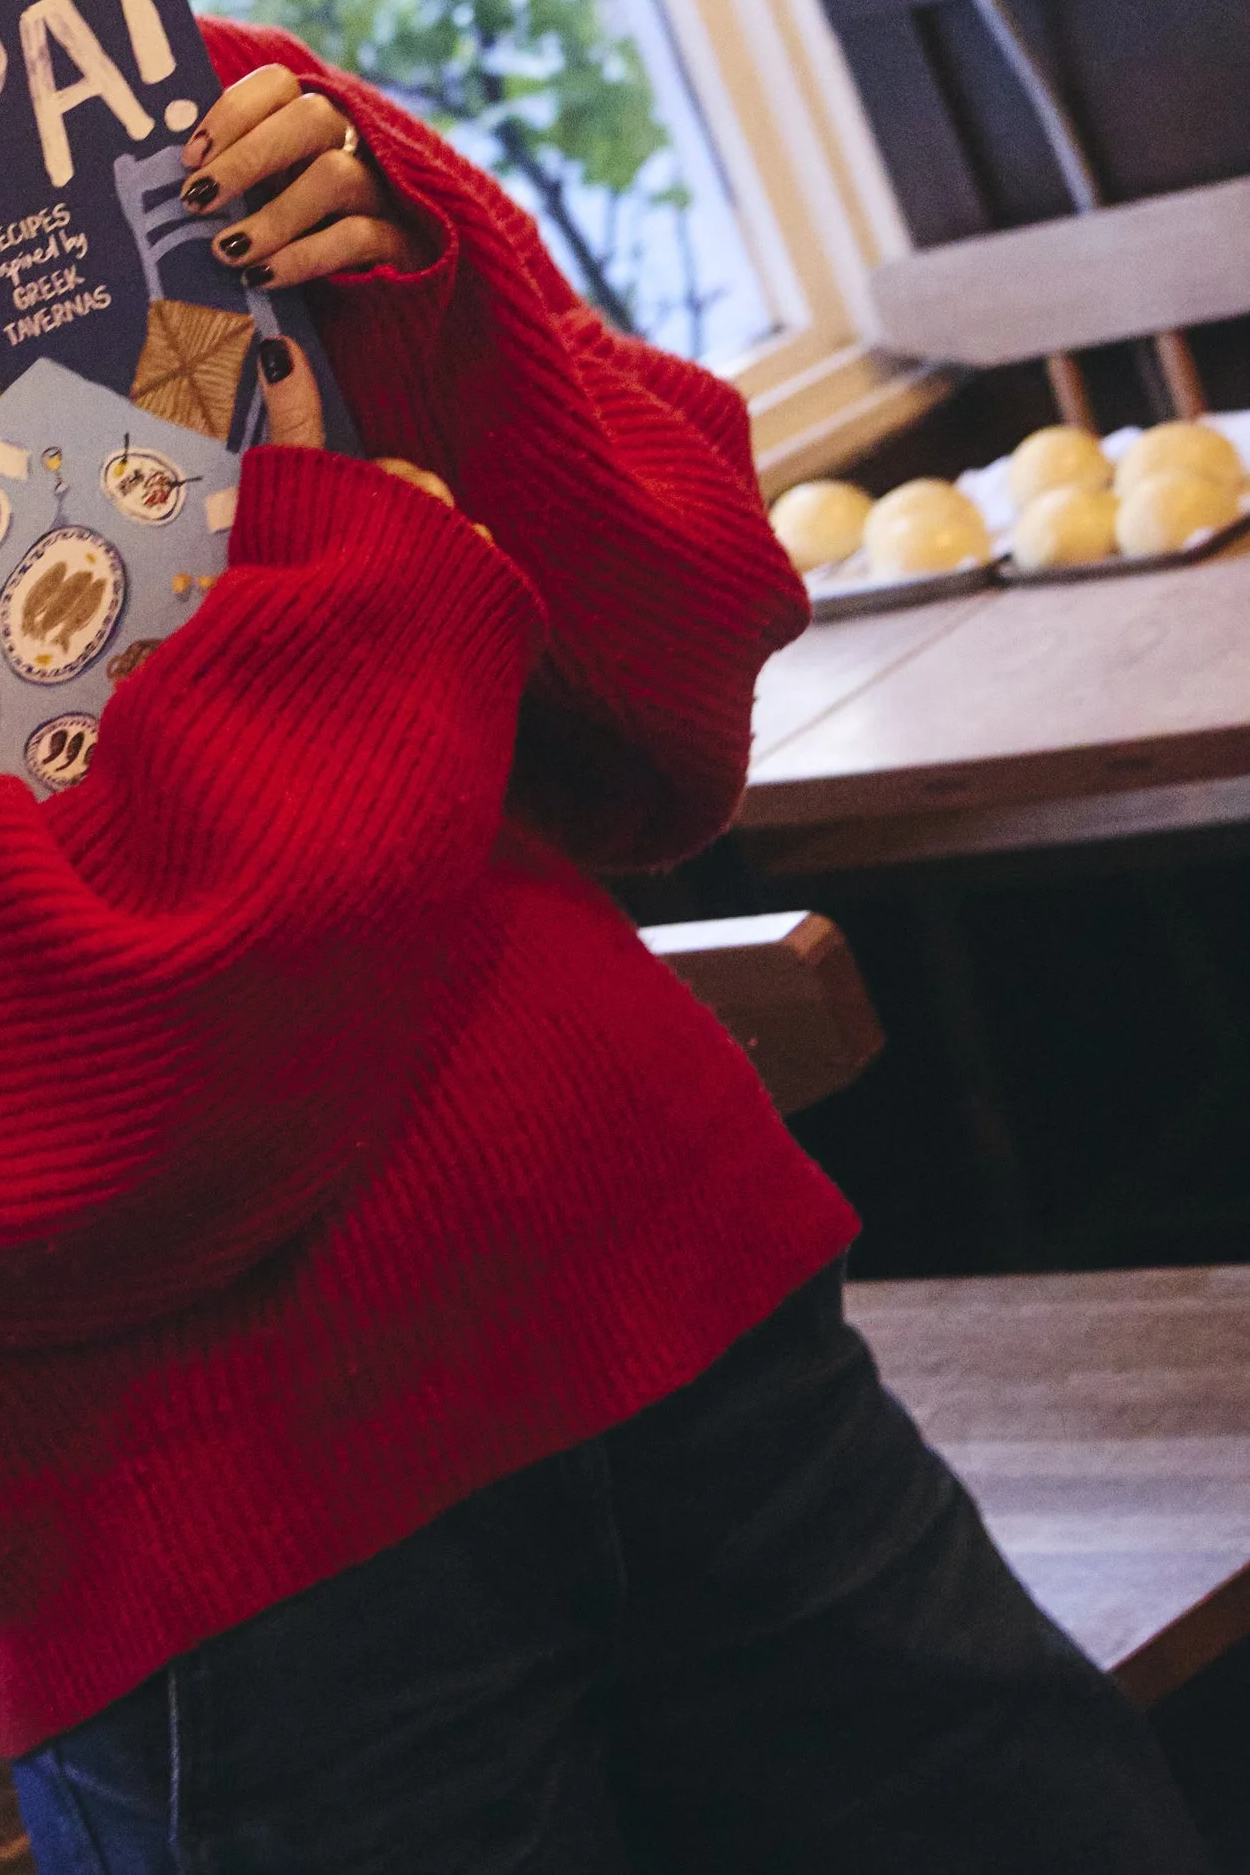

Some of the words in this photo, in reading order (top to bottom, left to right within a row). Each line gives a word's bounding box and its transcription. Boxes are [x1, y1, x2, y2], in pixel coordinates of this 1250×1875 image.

[58, 229, 88, 259] by
[12, 264, 85, 310] GREEK
[3, 284, 111, 346] TAVERNAS
